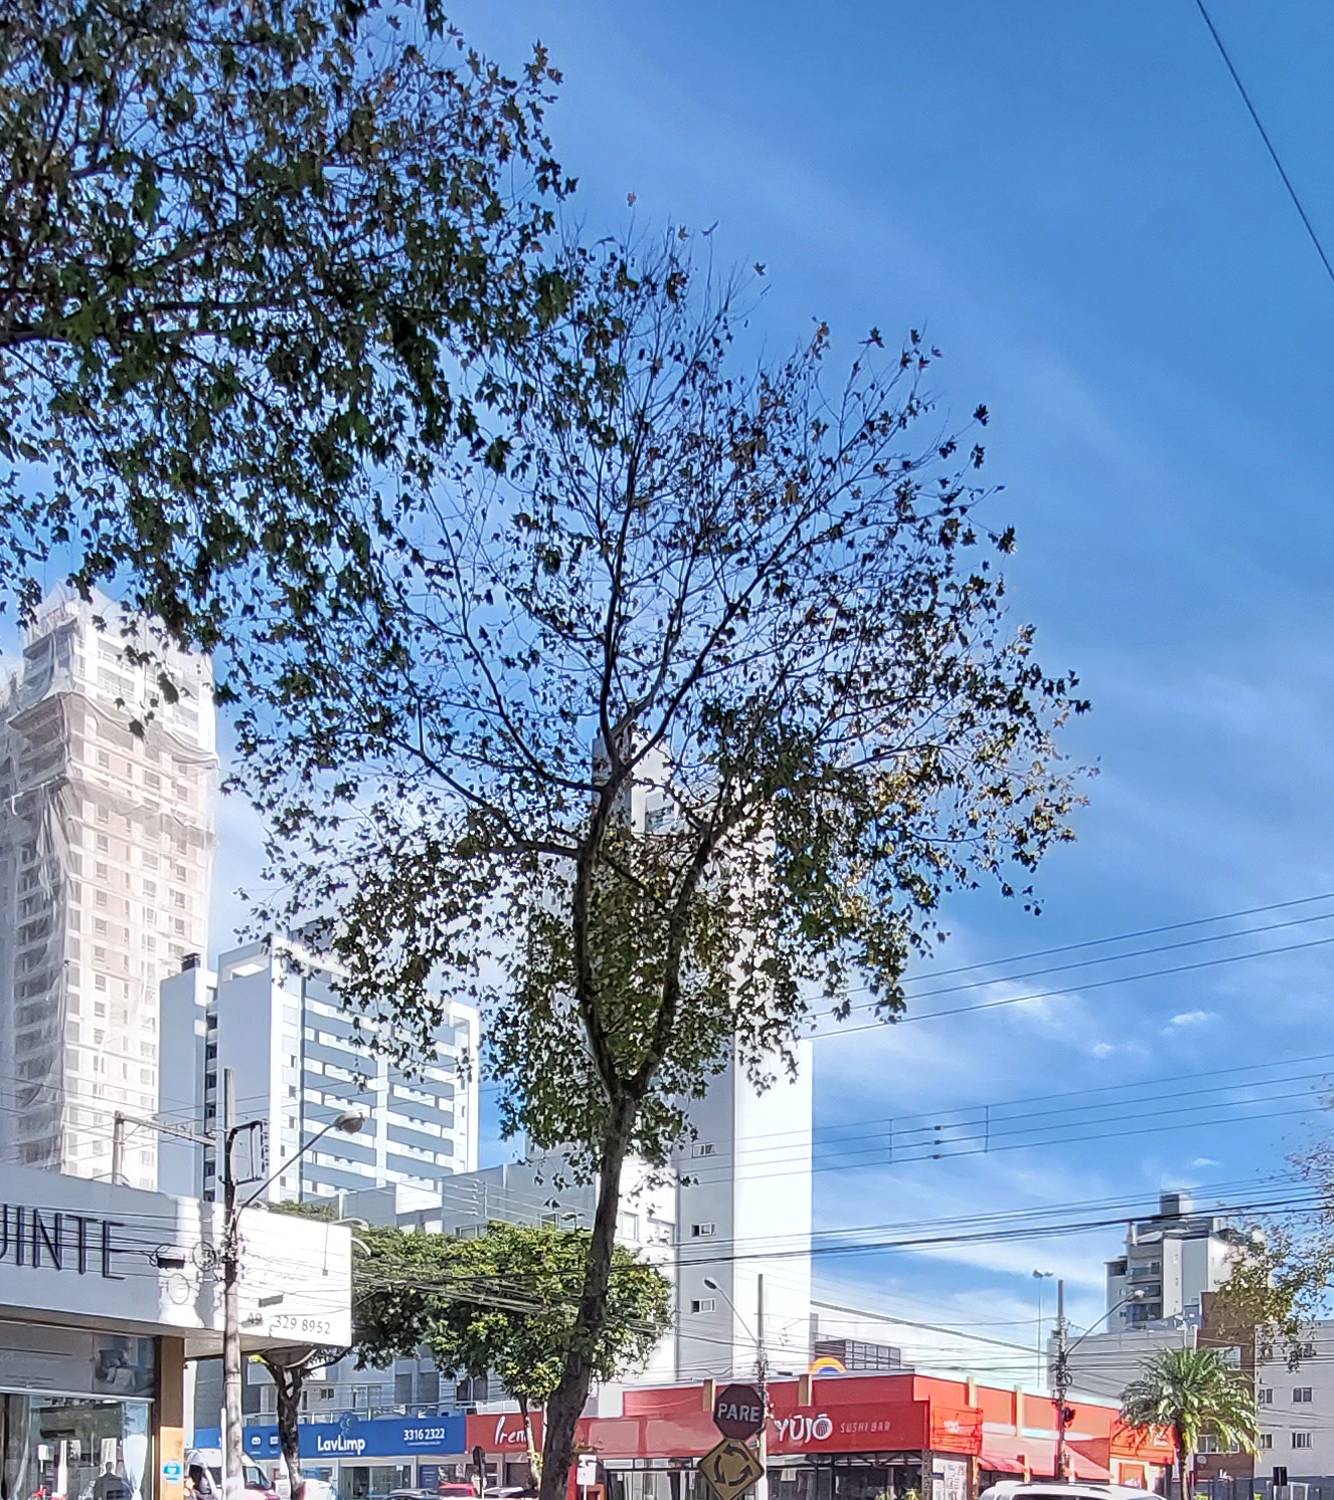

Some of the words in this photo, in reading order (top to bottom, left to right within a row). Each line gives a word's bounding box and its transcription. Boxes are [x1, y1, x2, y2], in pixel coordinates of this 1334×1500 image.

[301, 1318, 332, 1335] 8952
[718, 1403, 759, 1422] PARE
[403, 1430, 424, 1441] 3316
[425, 1428, 445, 1440] 2322
[840, 1421, 867, 1433] SUSHI
[871, 1421, 890, 1432] BAR
[317, 1434, 366, 1456] LavLimp
